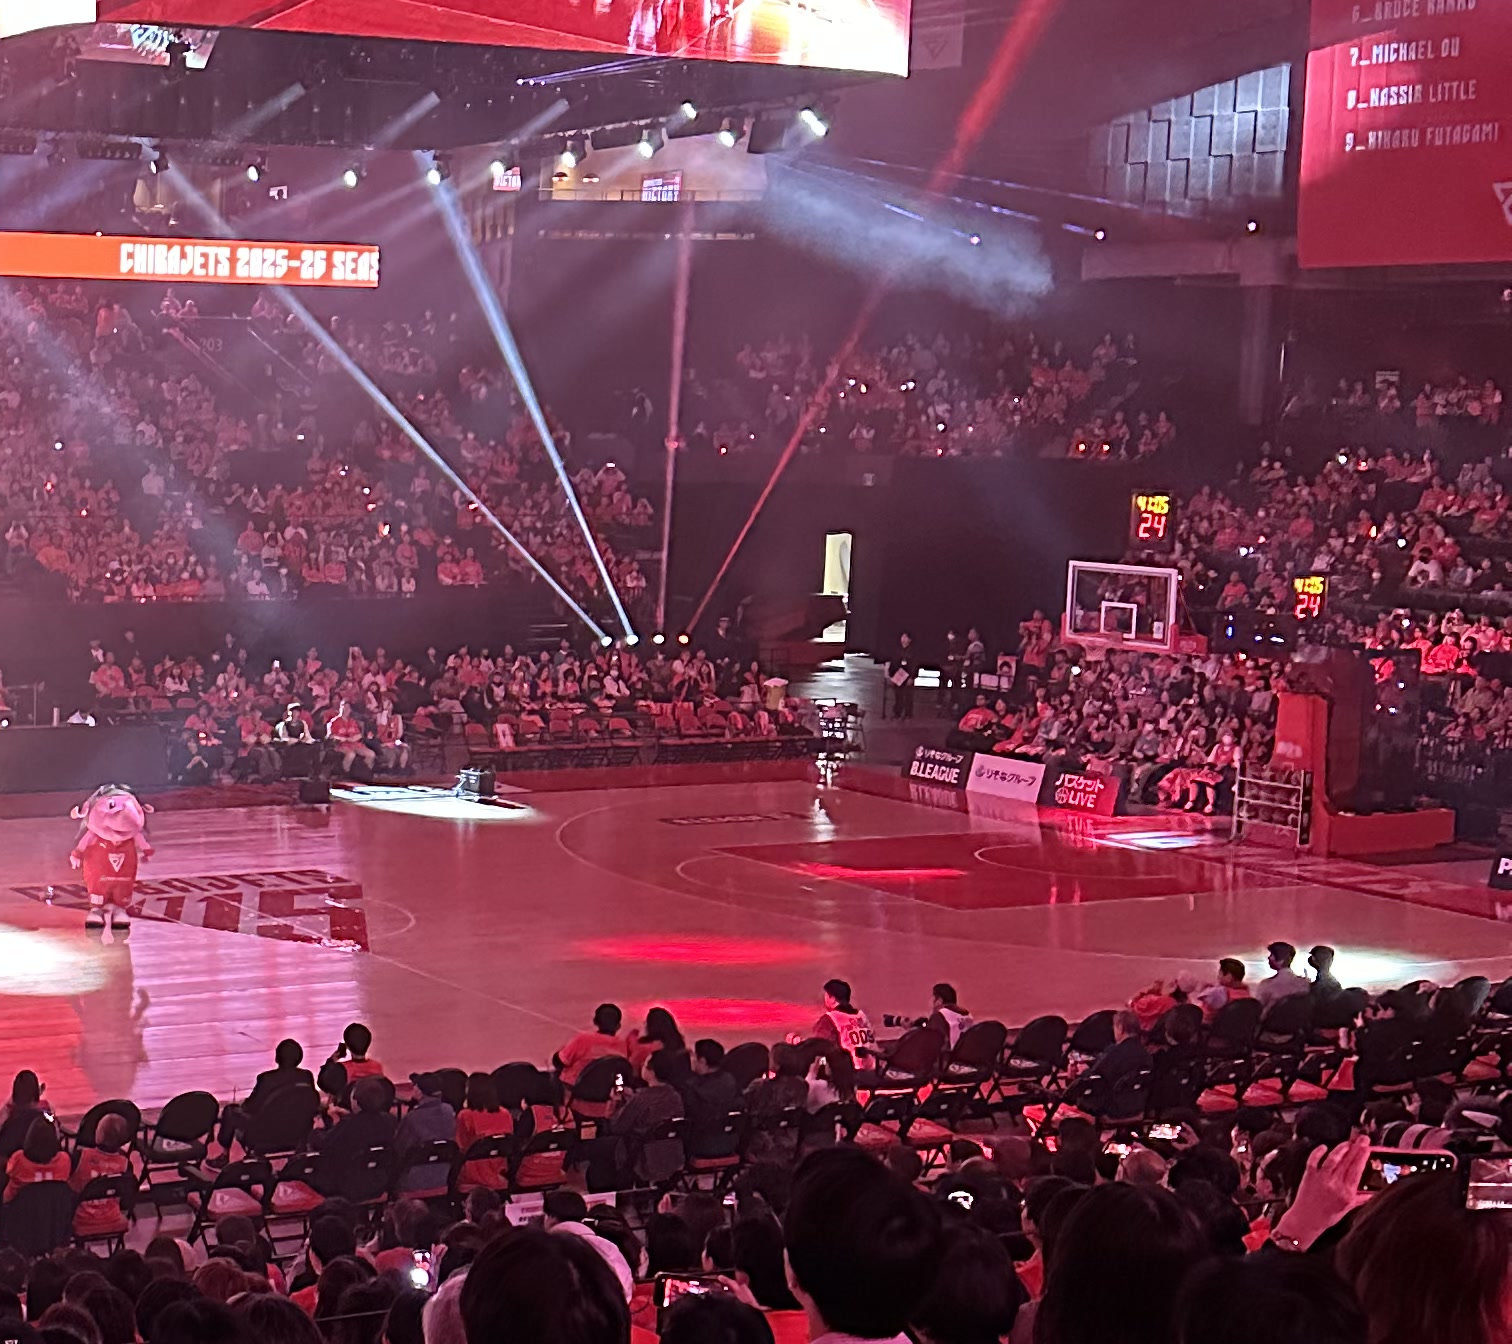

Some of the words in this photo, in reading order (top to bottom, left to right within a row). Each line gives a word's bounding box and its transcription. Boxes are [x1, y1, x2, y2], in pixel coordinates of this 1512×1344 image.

[1429, 79, 1478, 102] LITTLE
[119, 243, 231, 277] CHIBAJETS
[235, 246, 327, 280] 2025-26
[1138, 513, 1166, 538] 24
[1295, 594, 1321, 619] 24
[909, 761, 961, 784] B.LEAGUE
[1068, 790, 1097, 808] LIVE
